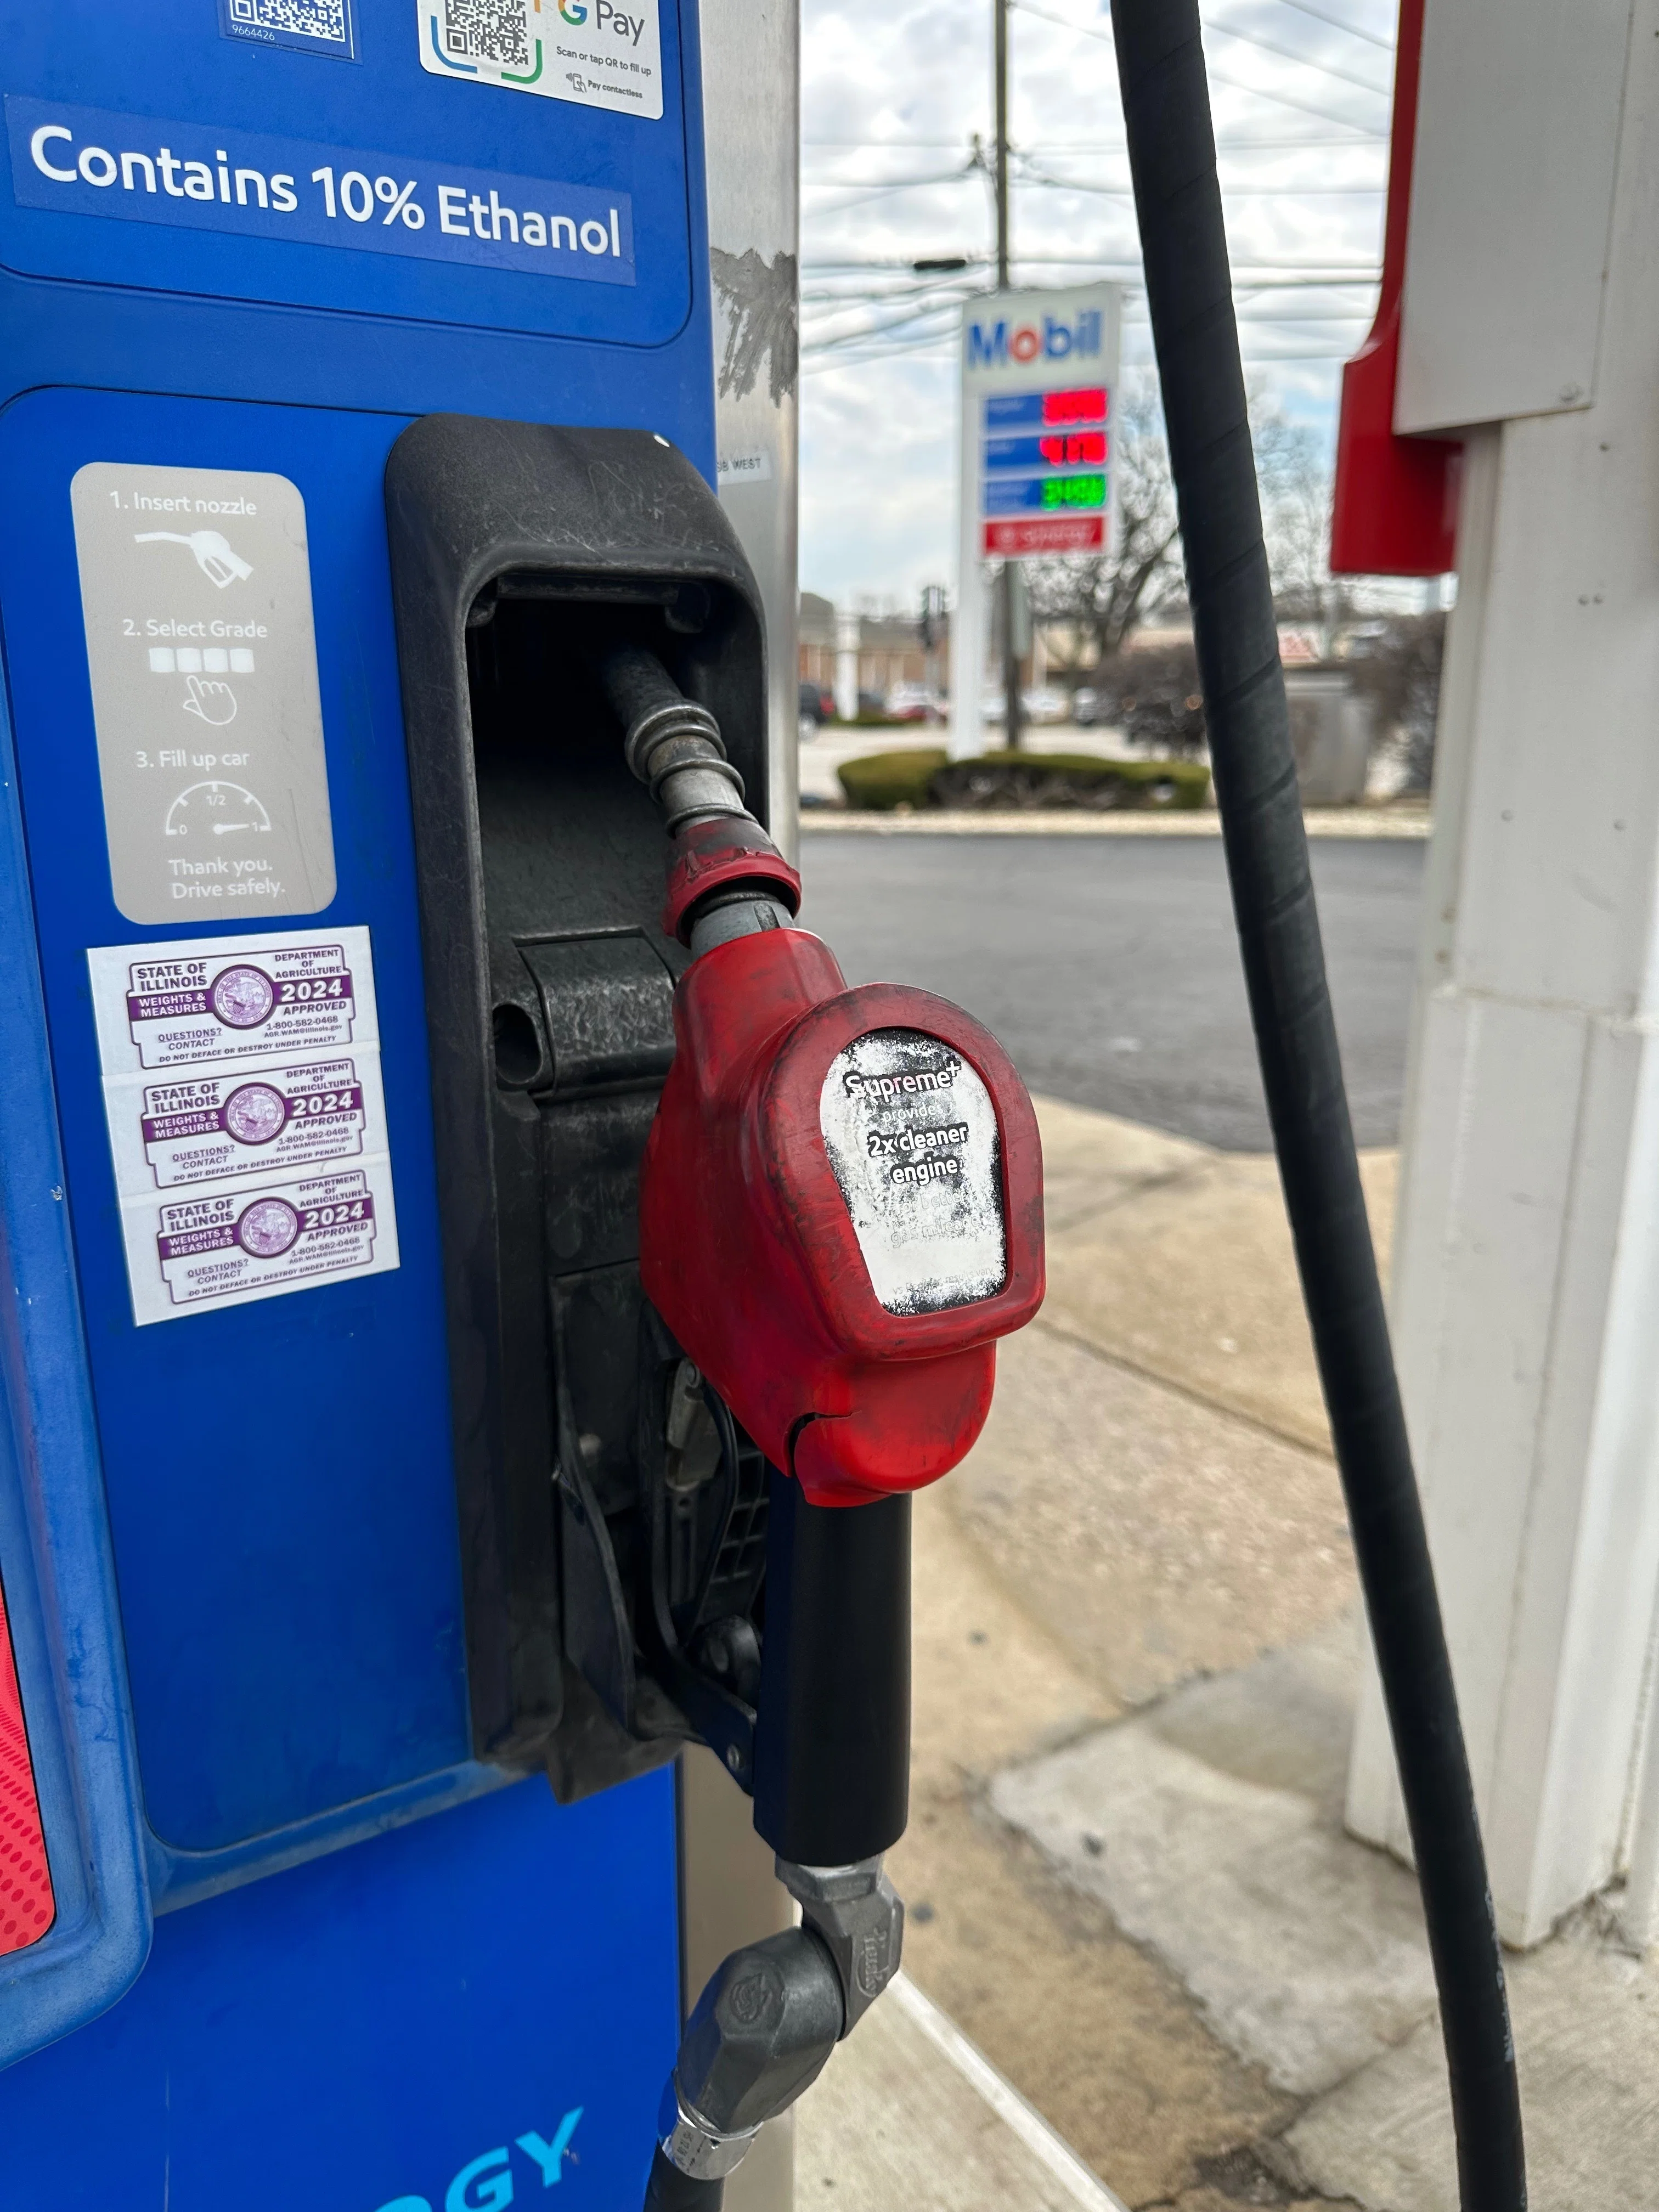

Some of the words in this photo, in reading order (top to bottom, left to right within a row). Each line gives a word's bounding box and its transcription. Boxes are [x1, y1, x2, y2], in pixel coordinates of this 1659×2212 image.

[596, 0, 645, 46] Pay
[232, 25, 275, 41] 9664426
[556, 46, 577, 59] Scan
[590, 55, 603, 66] tap
[605, 57, 618, 68] QR
[619, 61, 628, 70] to
[630, 63, 639, 73] fill
[641, 67, 651, 77] up
[588, 80, 601, 91] Pay
[602, 84, 643, 99] contactless
[31, 126, 298, 212] Contains
[312, 167, 425, 230] 10%
[438, 185, 621, 257] Ethanol
[969, 311, 1103, 370] Mobil
[731, 458, 761, 471] WEST
[110, 491, 129, 509] 1.
[135, 492, 191, 512] Insert
[196, 497, 257, 515] nozzle
[123, 619, 141, 636] 2.
[146, 619, 206, 637] Select
[210, 620, 268, 638] Grade
[136, 751, 154, 768] 3.
[160, 750, 186, 767] Fill
[193, 755, 216, 771] up
[222, 753, 250, 766] car
[206, 795, 227, 805] 1/2
[180, 825, 187, 834] 0
[168, 858, 229, 876] Thank
[233, 859, 273, 877] you.
[172, 882, 223, 899] Drive
[227, 878, 286, 898] safely.
[275, 950, 338, 962] DEPARTMENT
[138, 964, 183, 979] STATE
[188, 962, 207, 974] OF
[275, 966, 342, 979] AGRICULTURE
[141, 975, 207, 991] ILLINOIS
[281, 978, 343, 1002] 2024
[139, 994, 193, 1007] WEIGHTS
[197, 992, 206, 1001] &
[284, 1001, 347, 1015] APPROVED
[141, 1002, 206, 1017] MEASURES
[267, 1015, 338, 1030] 1-800-582-0468
[158, 1028, 222, 1042] QUESTIONS?
[168, 1038, 215, 1050] CONTACT
[192, 1049, 222, 1058] DEFACE
[238, 1043, 273, 1052] DESTROY
[304, 1036, 336, 1044] PENALTY
[286, 1063, 349, 1078] DEPARTMENT
[152, 1086, 196, 1101] STATE
[201, 1082, 219, 1094] OF
[287, 1079, 352, 1094] AGRICULTURE
[155, 1094, 219, 1114] ILLINOIS
[292, 1091, 353, 1117] 2024
[154, 1113, 206, 1128] WEIGHTS
[210, 1111, 219, 1120] &
[295, 1112, 357, 1130] APPROVED
[882, 1102, 944, 1127] provides
[156, 1121, 219, 1138] MEASURES
[868, 1136, 896, 1157] 2x
[900, 1127, 967, 1151] cleaner
[172, 1144, 235, 1162] QUESTIONS?
[183, 1155, 228, 1169] CONTACT
[206, 1165, 235, 1175] DEFACE
[251, 1158, 285, 1168] DESTROY
[287, 1152, 313, 1161] UNDER
[315, 1146, 347, 1156] PENALTY
[893, 1156, 958, 1186] engine
[299, 1174, 361, 1192] DEPARTMENT
[325, 1186, 337, 1194] OF
[300, 1189, 363, 1207] AGRICULTURE
[903, 1200, 918, 1214] or
[920, 1191, 968, 1210] better
[167, 1203, 211, 1220] STATE
[216, 1199, 234, 1210] OF
[305, 1201, 365, 1229] 2024
[171, 1211, 235, 1231] ILLINOIS
[169, 1229, 221, 1246] WEIGHTS
[224, 1227, 233, 1235] &
[307, 1222, 368, 1242] APPROVED
[891, 1227, 918, 1248] gas
[922, 1215, 981, 1237] mileage
[171, 1236, 234, 1256] MEASURES
[187, 1259, 249, 1277] QUESTIONS?
[198, 1269, 241, 1284] CONTACT
[220, 1279, 249, 1289] DEFACE
[264, 1269, 297, 1280] DESTROY
[300, 1263, 325, 1272] UNDER
[327, 1255, 358, 1267] PENALTY
[374, 2106, 584, 2212] GY
